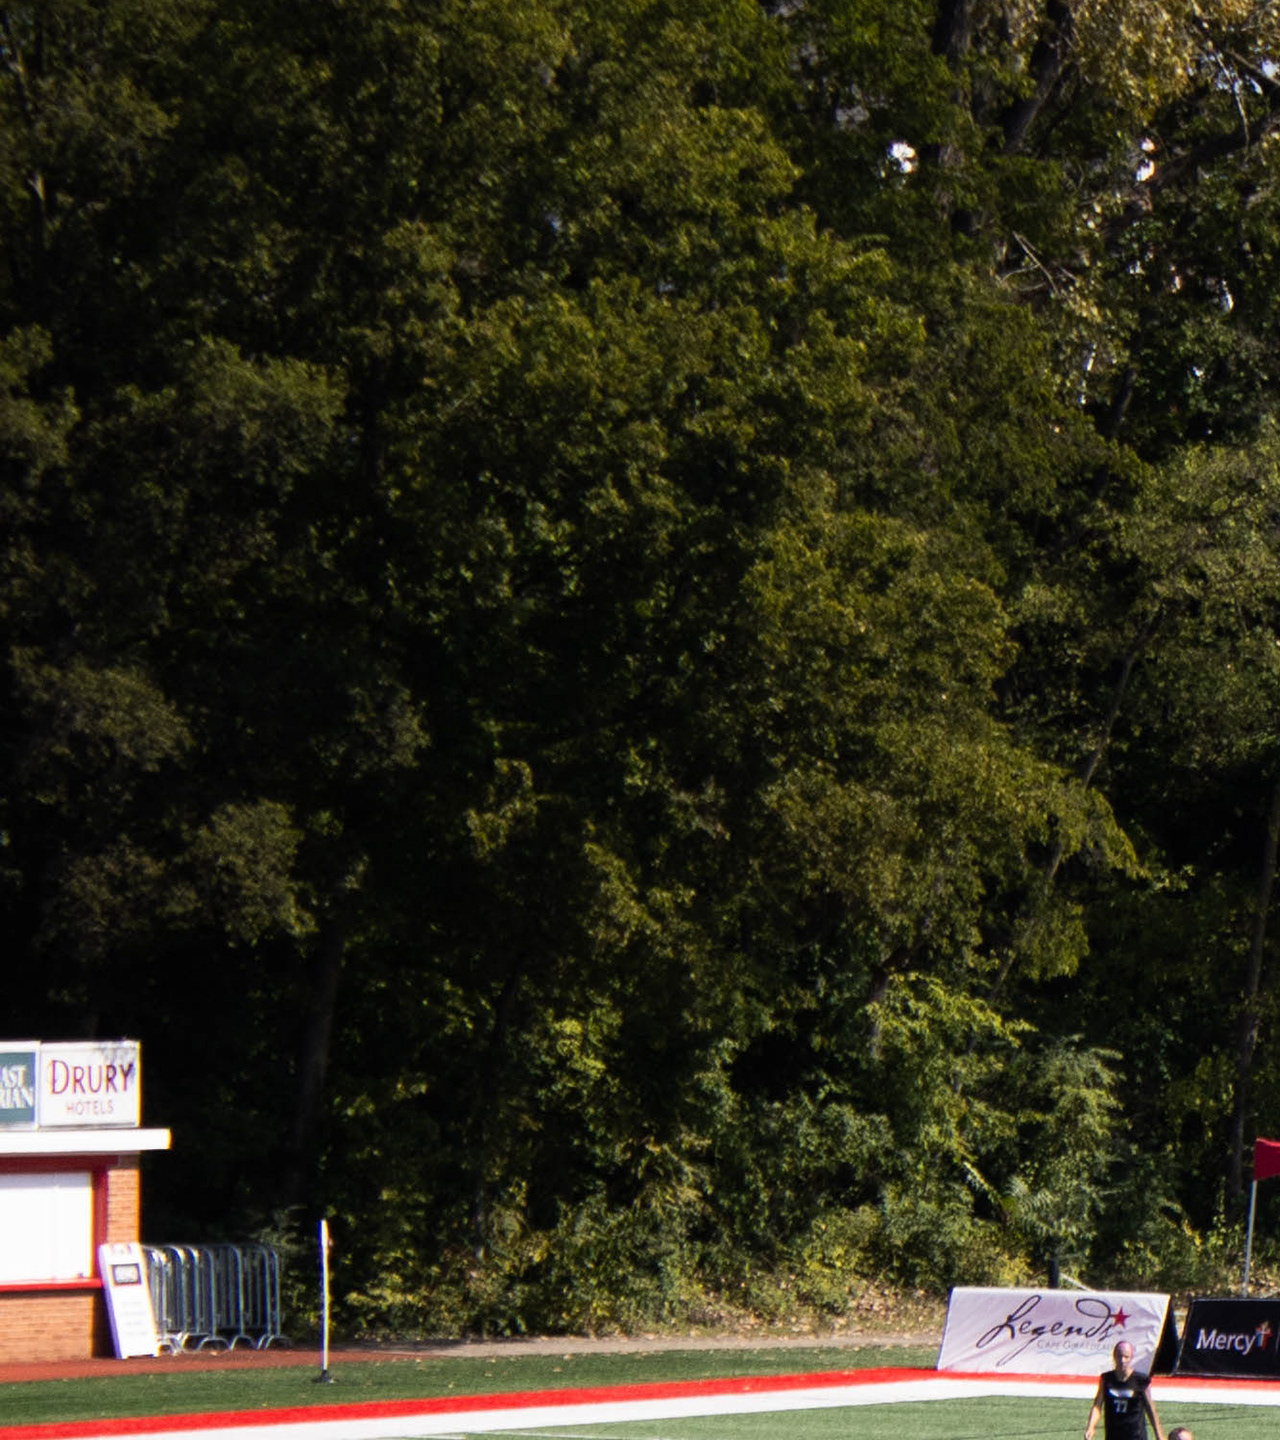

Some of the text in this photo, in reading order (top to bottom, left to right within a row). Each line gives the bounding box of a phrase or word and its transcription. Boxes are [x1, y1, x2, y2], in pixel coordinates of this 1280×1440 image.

[50, 1059, 134, 1094] DRURY
[66, 1099, 114, 1116] HOTELS
[1196, 1329, 1256, 1355] Mercy
